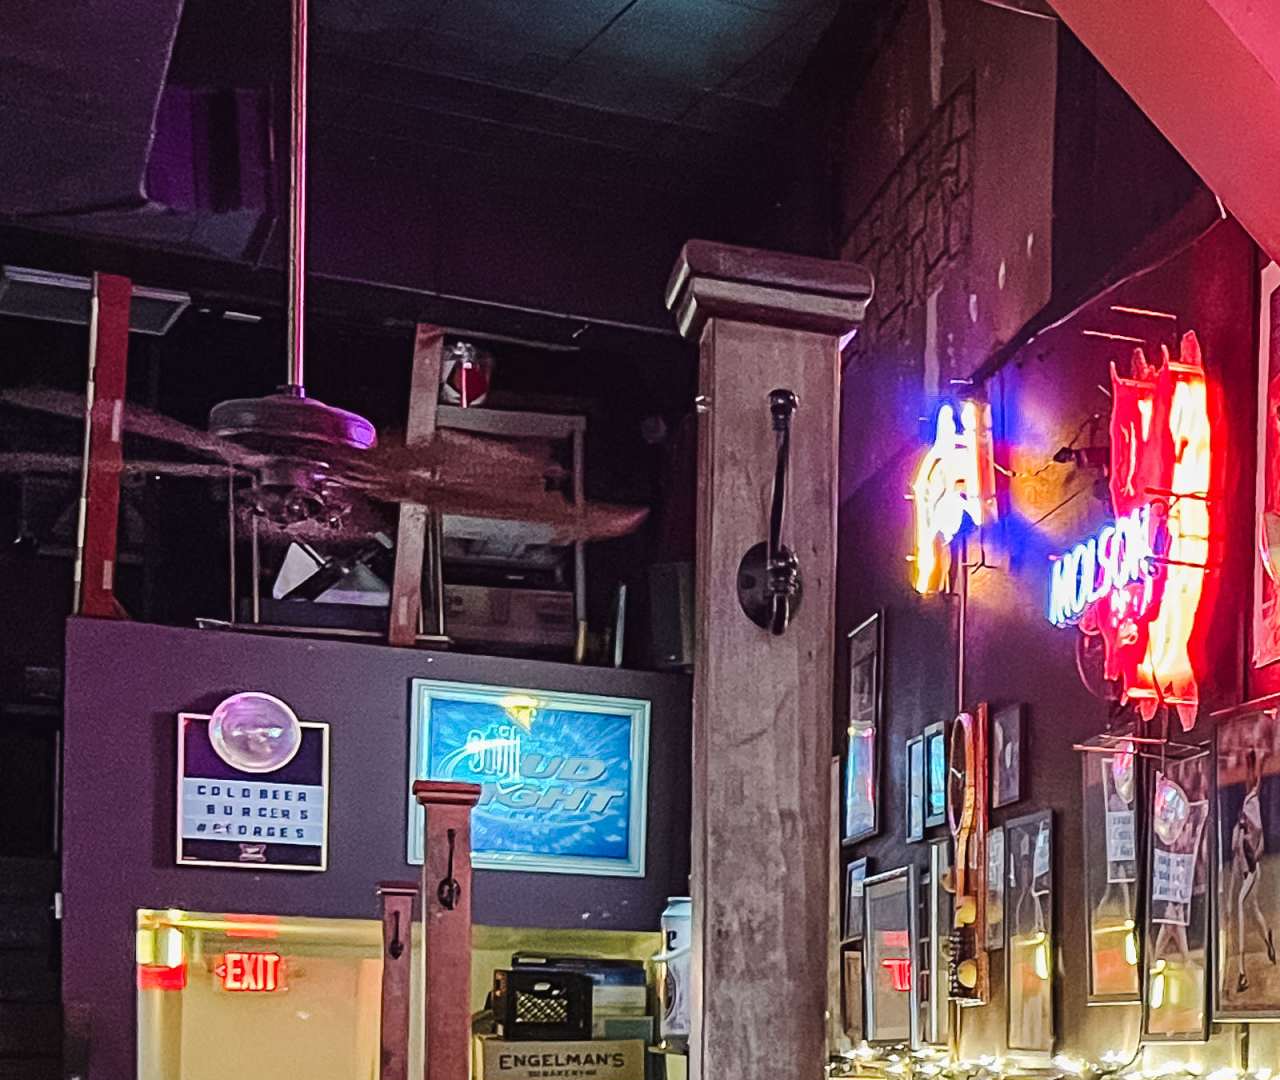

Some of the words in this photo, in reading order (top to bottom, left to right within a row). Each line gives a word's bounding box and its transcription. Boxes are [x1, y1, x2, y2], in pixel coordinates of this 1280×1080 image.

[197, 785, 251, 799] COLD
[259, 789, 307, 802] BEER
[225, 953, 280, 991] EXIT
[499, 1052, 625, 1070] ENGELMAN'S
